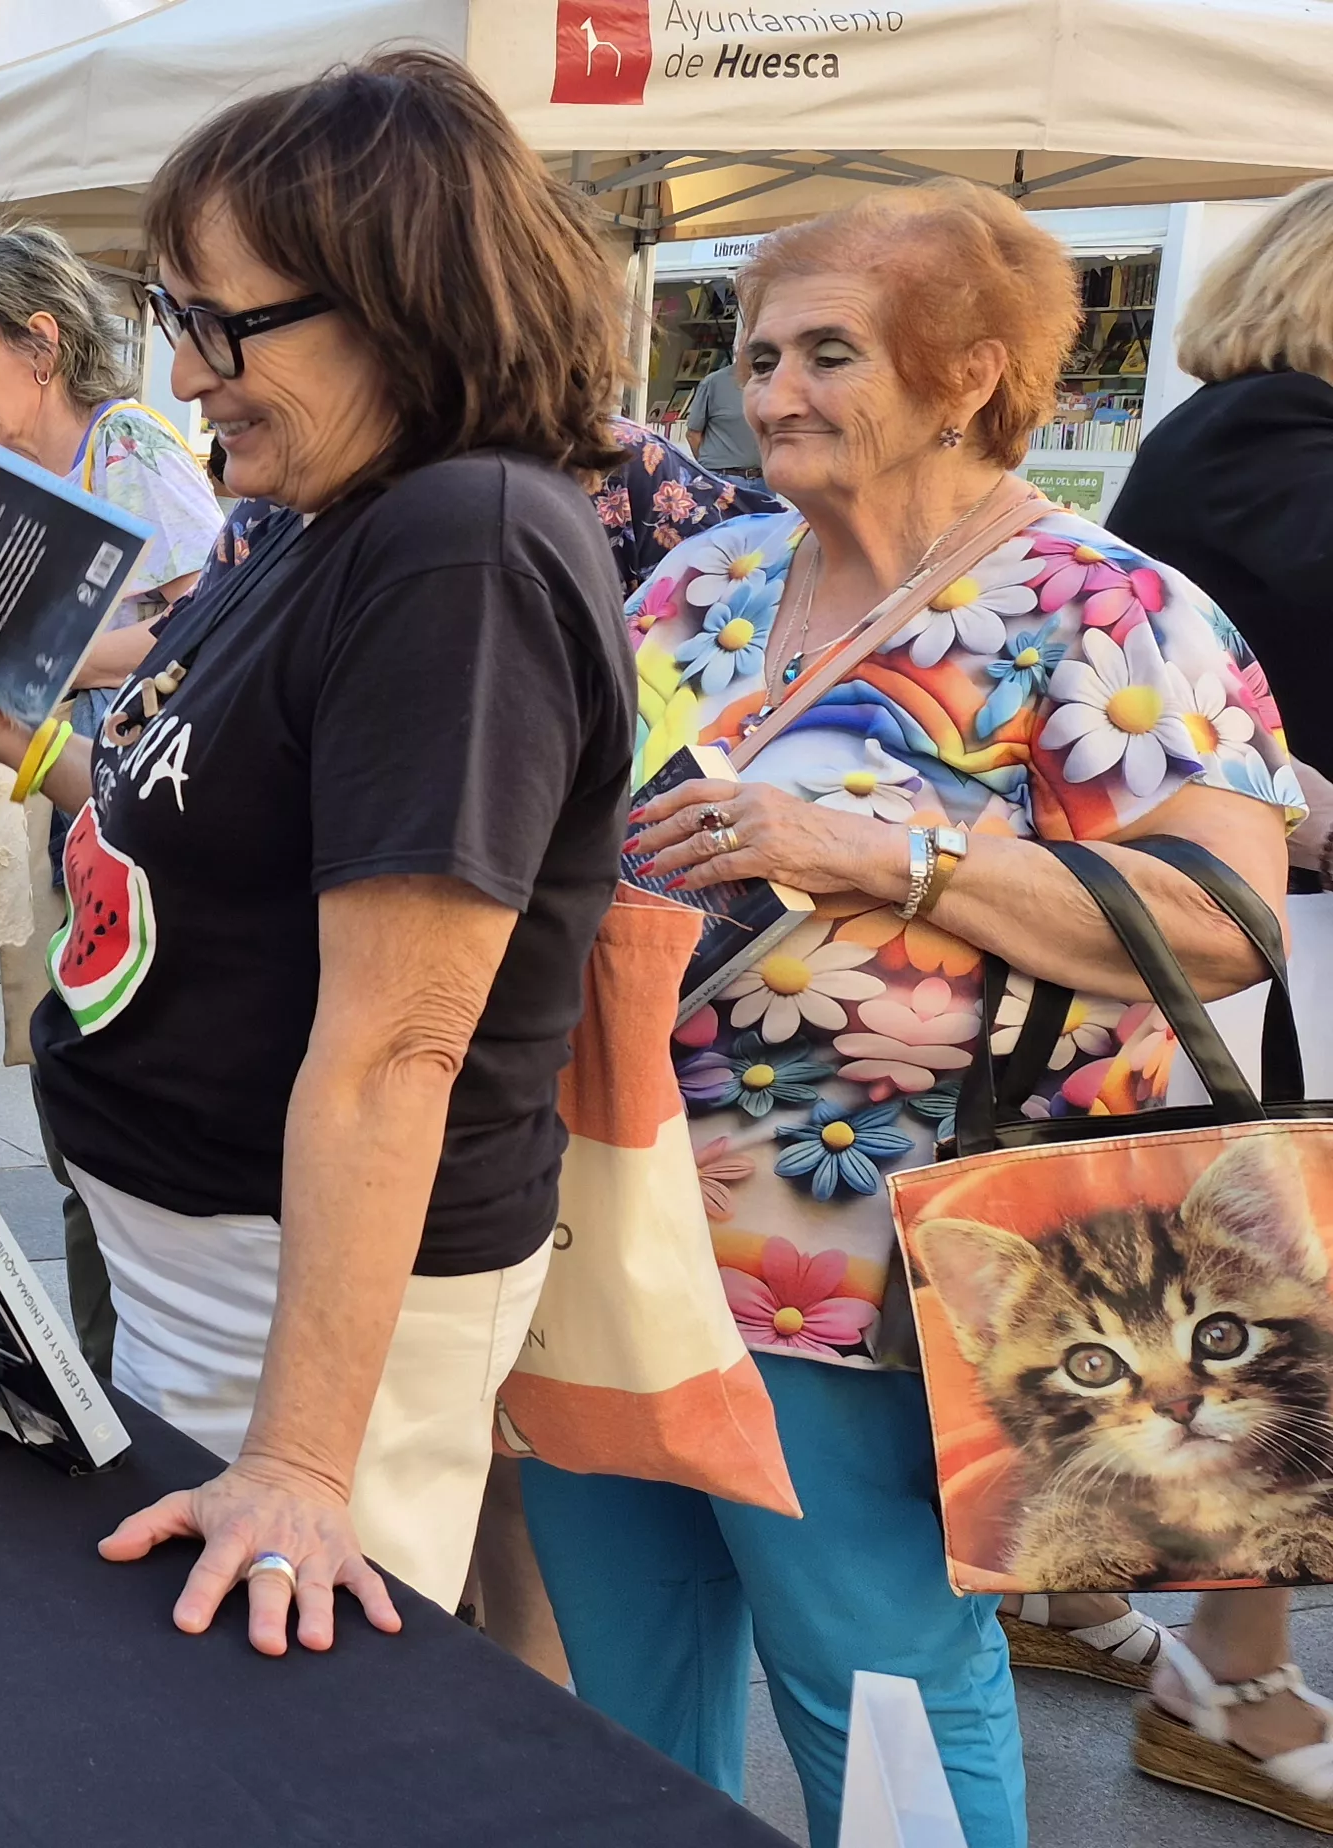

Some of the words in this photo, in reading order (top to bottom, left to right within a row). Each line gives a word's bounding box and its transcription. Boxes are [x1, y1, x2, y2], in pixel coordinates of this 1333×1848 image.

[664, 0, 904, 40] Ayuntamiento
[664, 44, 704, 79] de
[713, 44, 840, 79] Huesca
[1056, 477, 1071, 486] DEL
[1073, 478, 1098, 487] LIBRO
[15, 1277, 45, 1327] ENIGMA
[40, 1324, 56, 1340] EL
[73, 1387, 94, 1412] LAS
